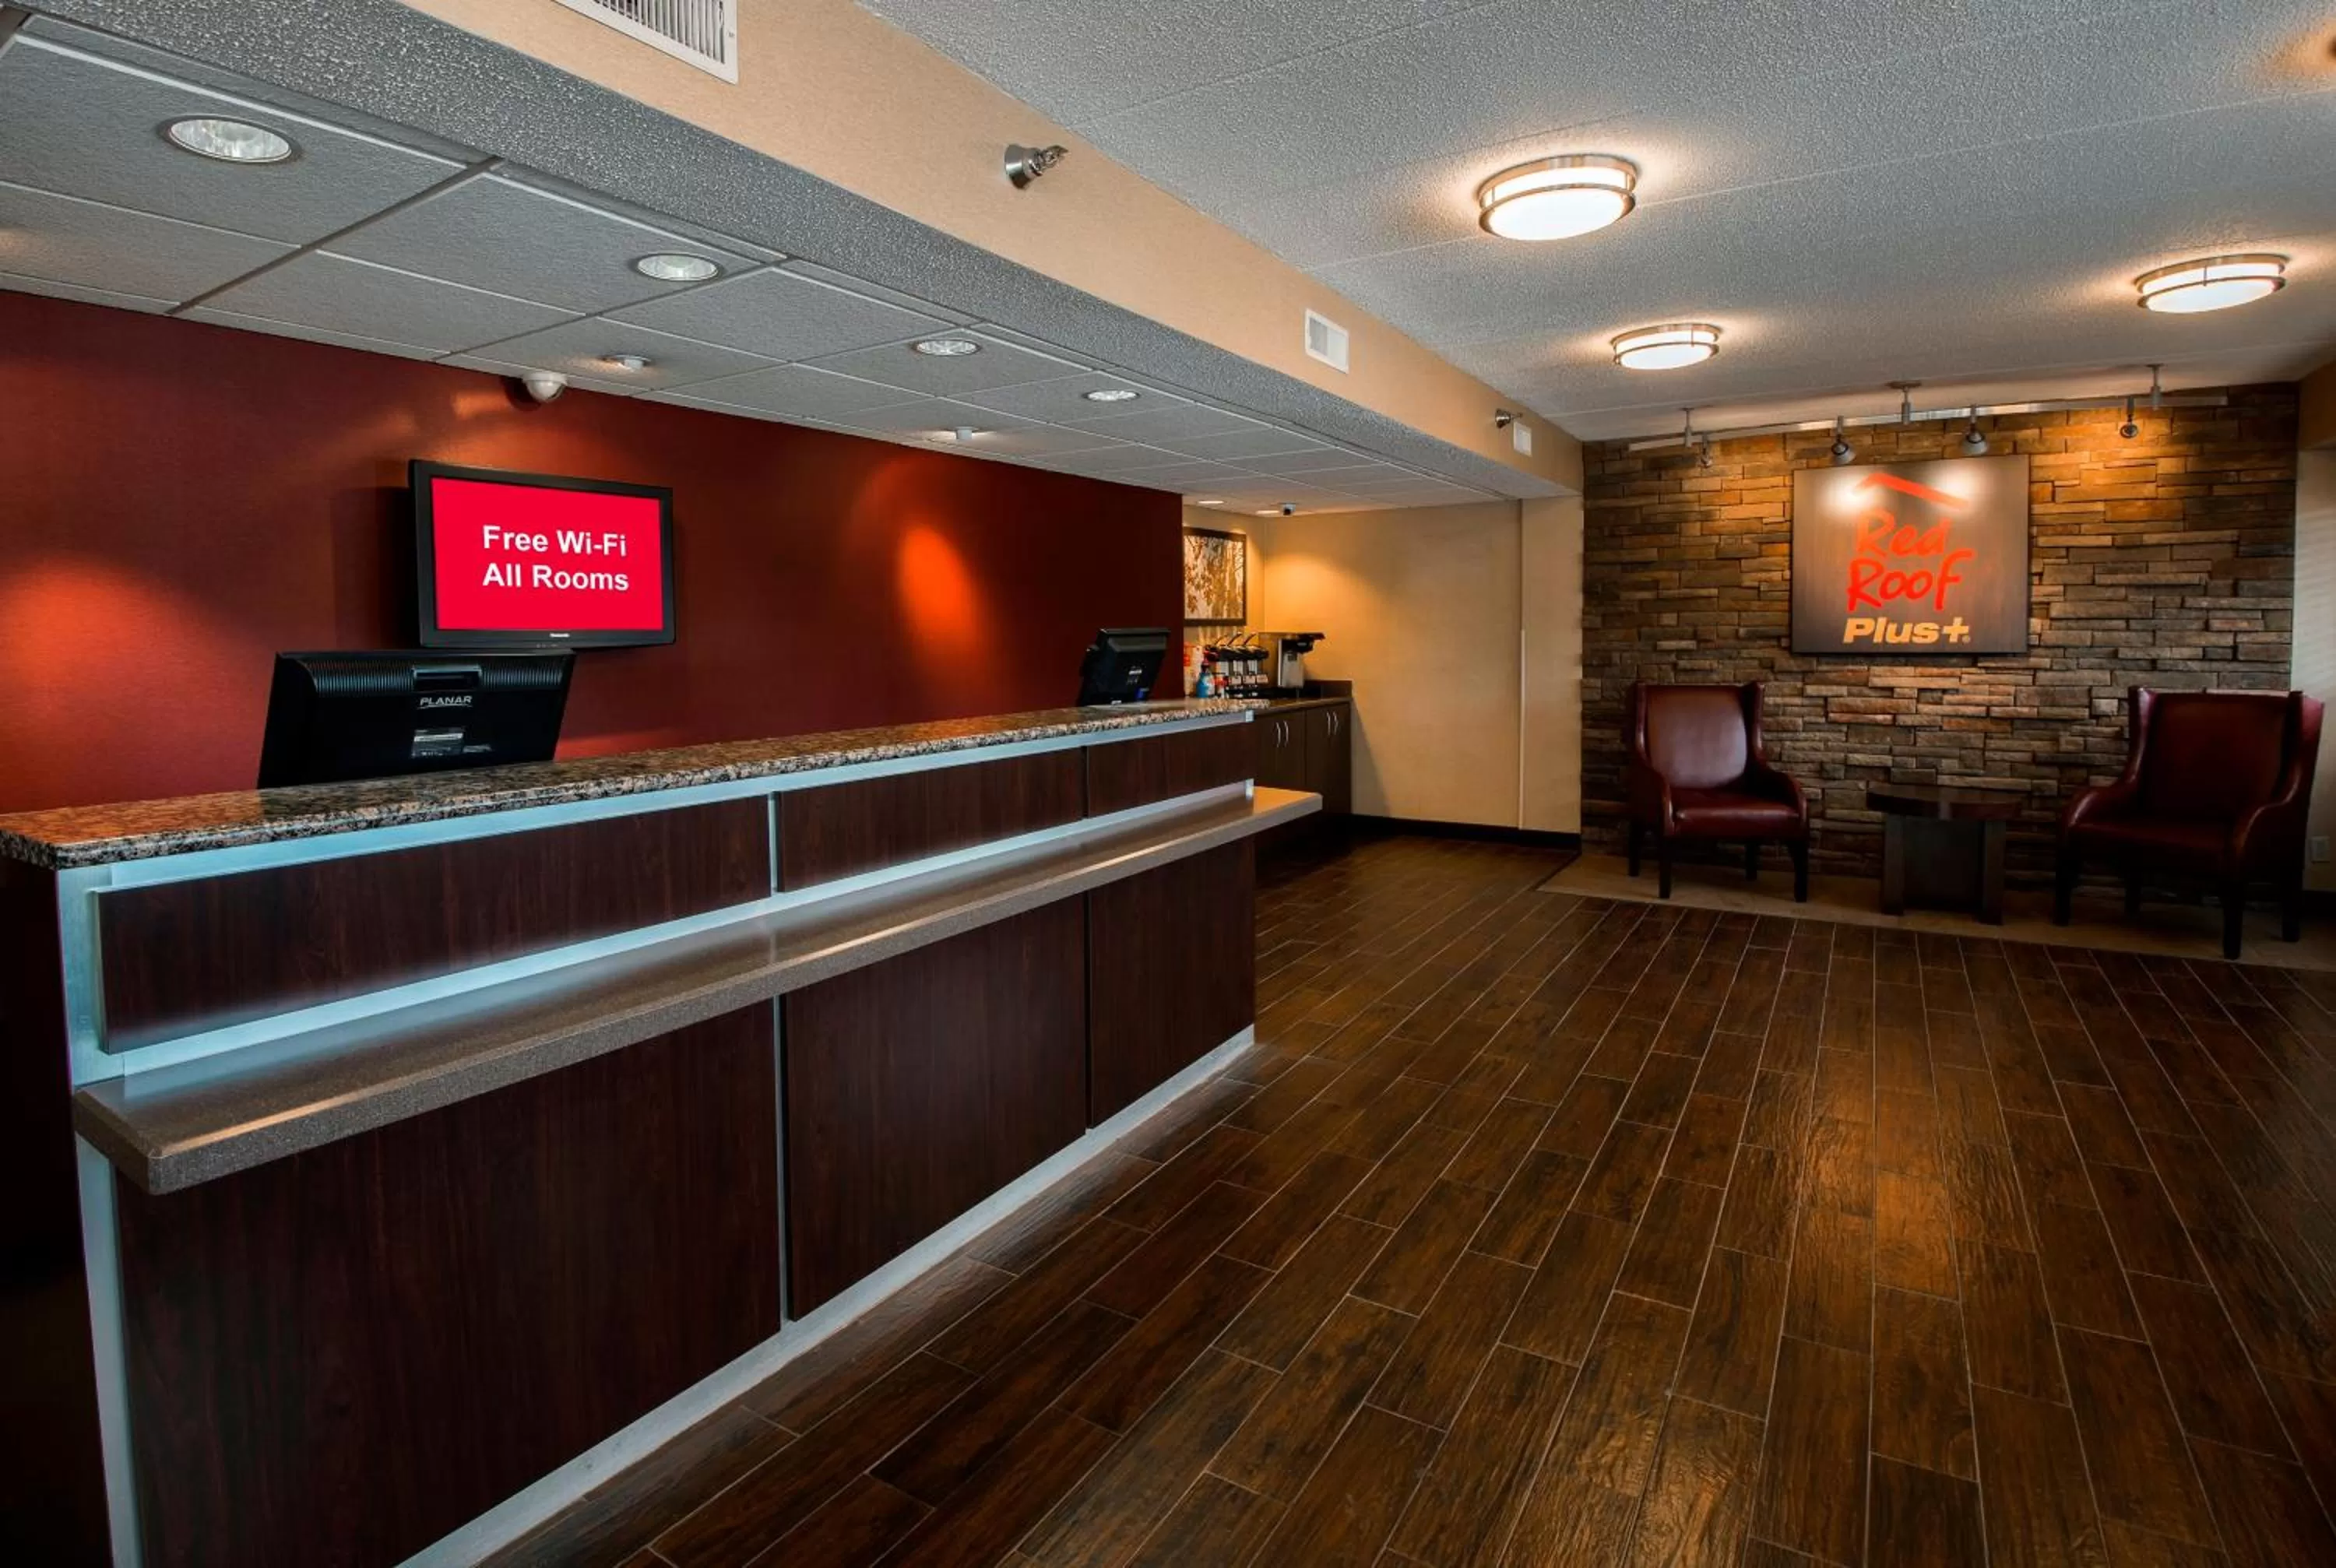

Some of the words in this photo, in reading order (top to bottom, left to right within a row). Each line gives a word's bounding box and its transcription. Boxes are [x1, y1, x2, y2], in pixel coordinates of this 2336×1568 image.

[482, 525, 549, 552] Free
[557, 529, 627, 557] Wi-Fi
[1856, 508, 1952, 559] Red
[482, 563, 521, 587] All
[533, 564, 630, 591] Rooms
[1846, 547, 1976, 611] Roof
[420, 695, 473, 705] PLANAR
